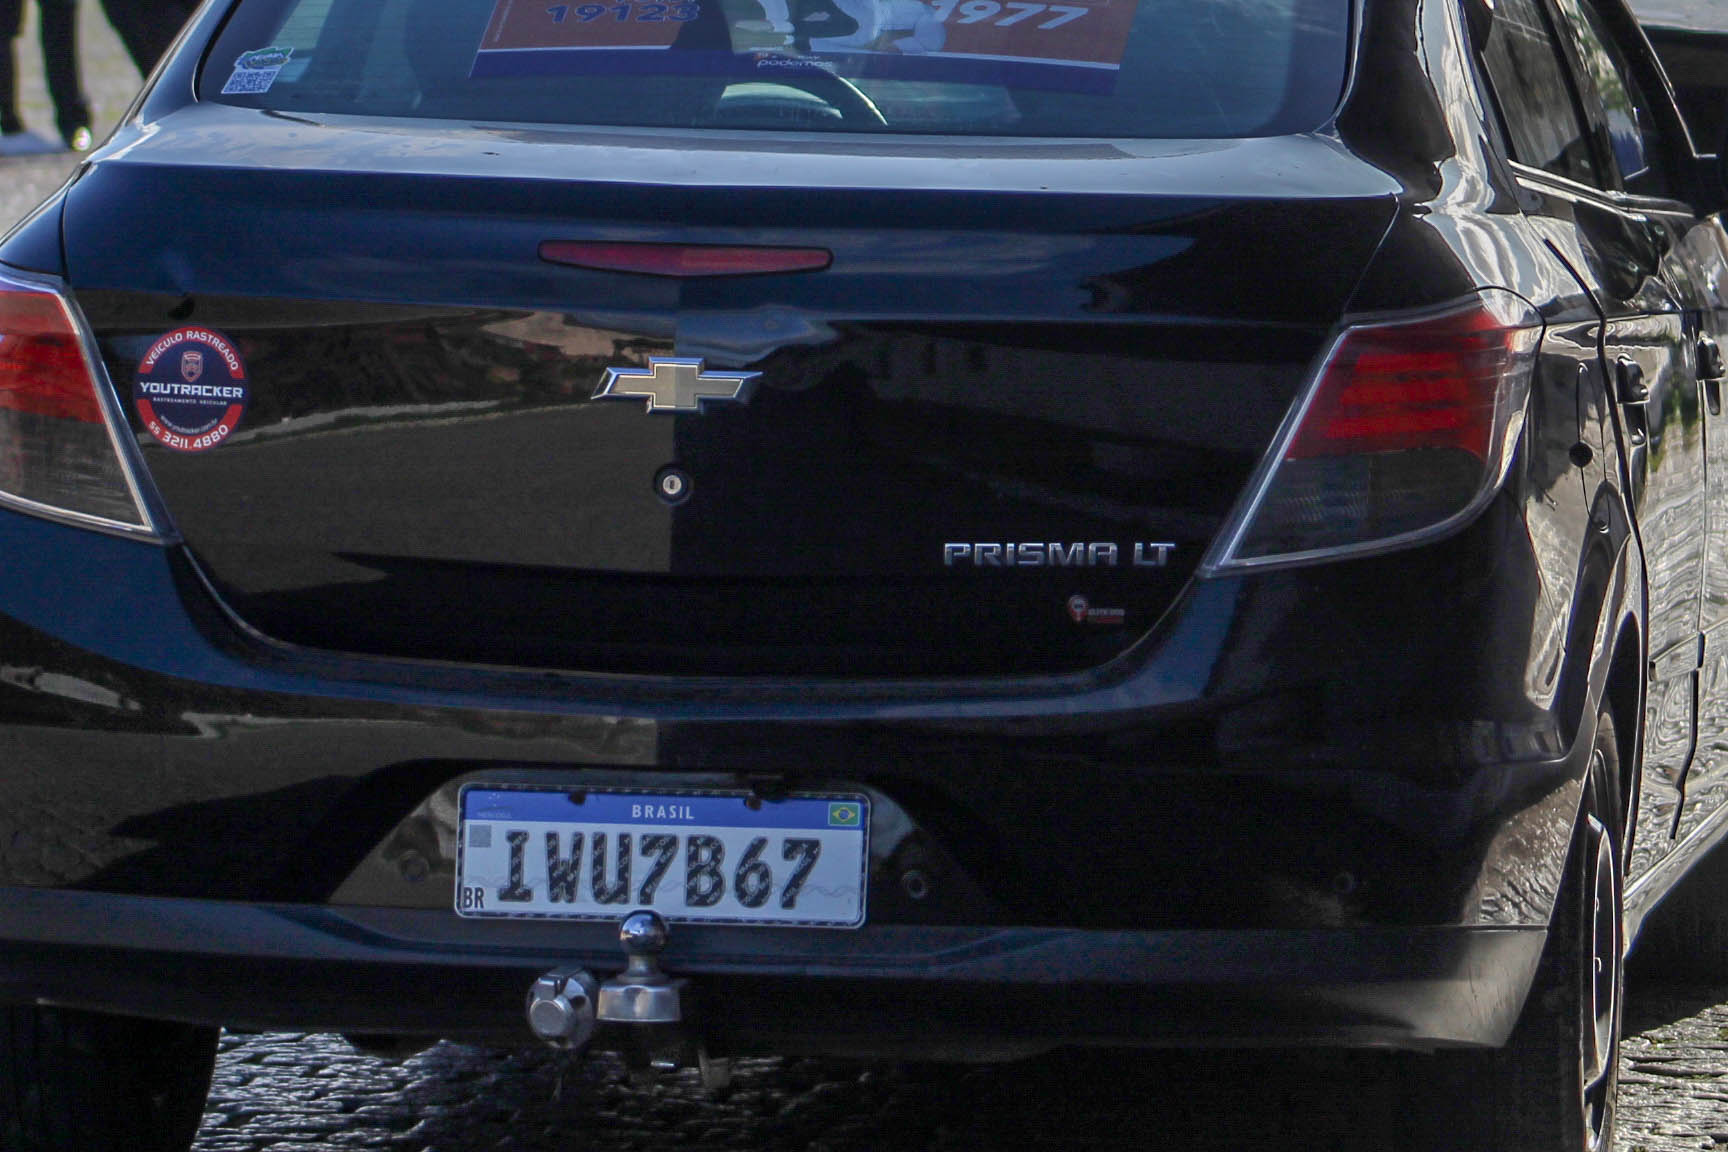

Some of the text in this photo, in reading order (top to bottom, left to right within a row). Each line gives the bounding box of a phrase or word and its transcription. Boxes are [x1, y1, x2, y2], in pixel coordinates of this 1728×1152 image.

[545, 2, 701, 24] 19123
[186, 330, 239, 371] RASTREADO
[139, 381, 243, 398] YOUTRACKER
[148, 421, 229, 449] 55 3211.4880
[944, 542, 1177, 567] PRISMA LT
[630, 803, 696, 821] BRASIL
[496, 831, 822, 911] IWU7B67
[463, 886, 486, 910] BR
